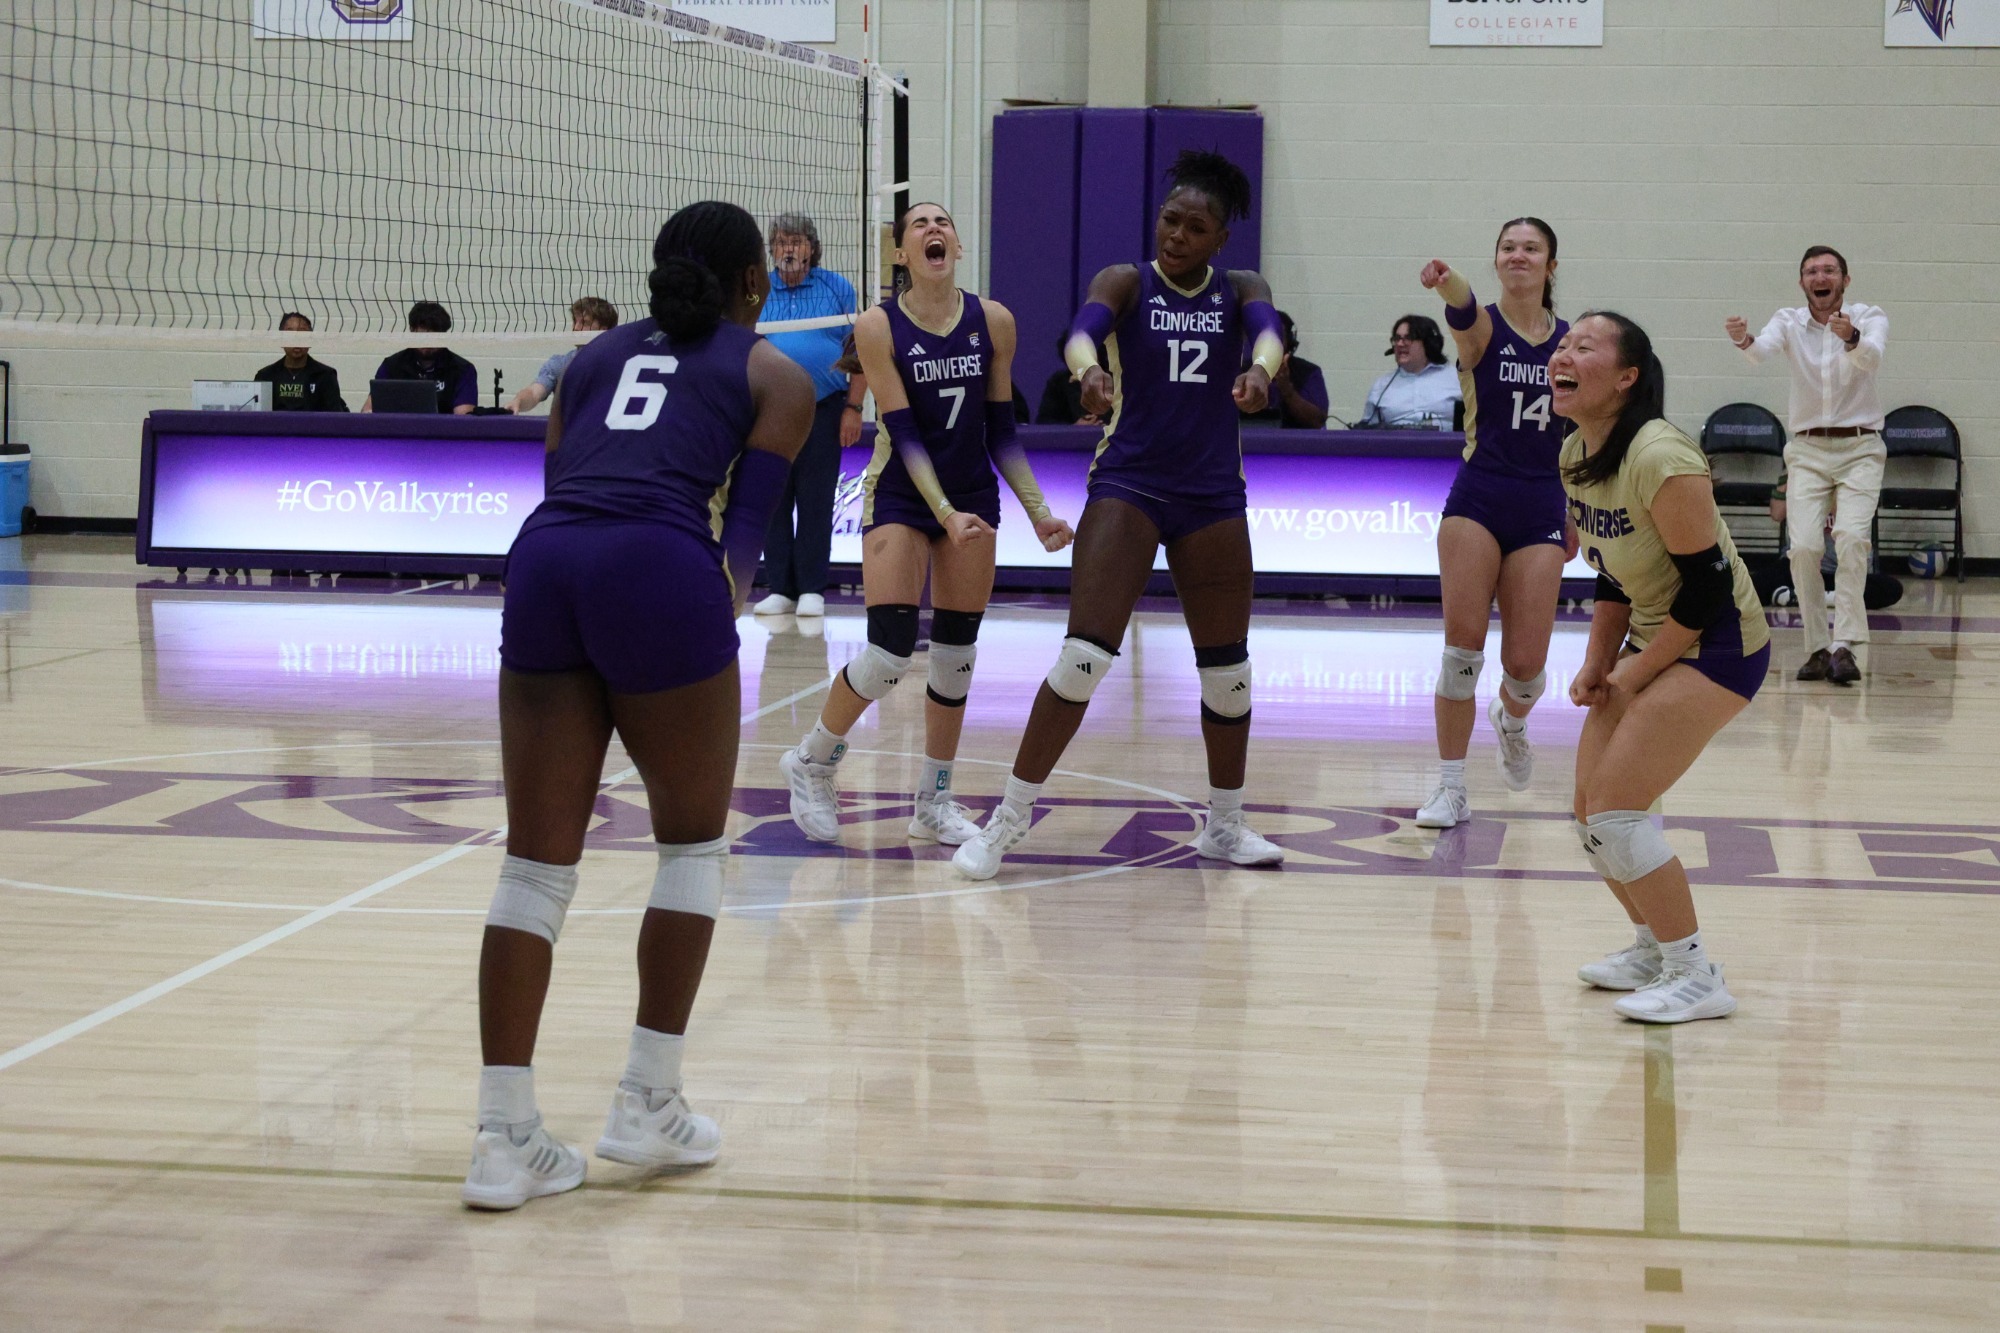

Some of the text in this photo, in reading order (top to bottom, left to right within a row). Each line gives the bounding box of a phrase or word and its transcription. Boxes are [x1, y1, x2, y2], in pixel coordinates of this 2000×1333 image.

[1454, 17, 1578, 28] COLLEGIATE
[1487, 34, 1544, 44] SELECT
[1150, 309, 1224, 333] CONVERSE
[913, 354, 982, 382] CONVERSE
[1167, 339, 1209, 383] 12
[604, 354, 679, 430] 6
[938, 386, 965, 429] 7
[1511, 391, 1551, 431] 14
[276, 480, 509, 521] #GoValkyries
